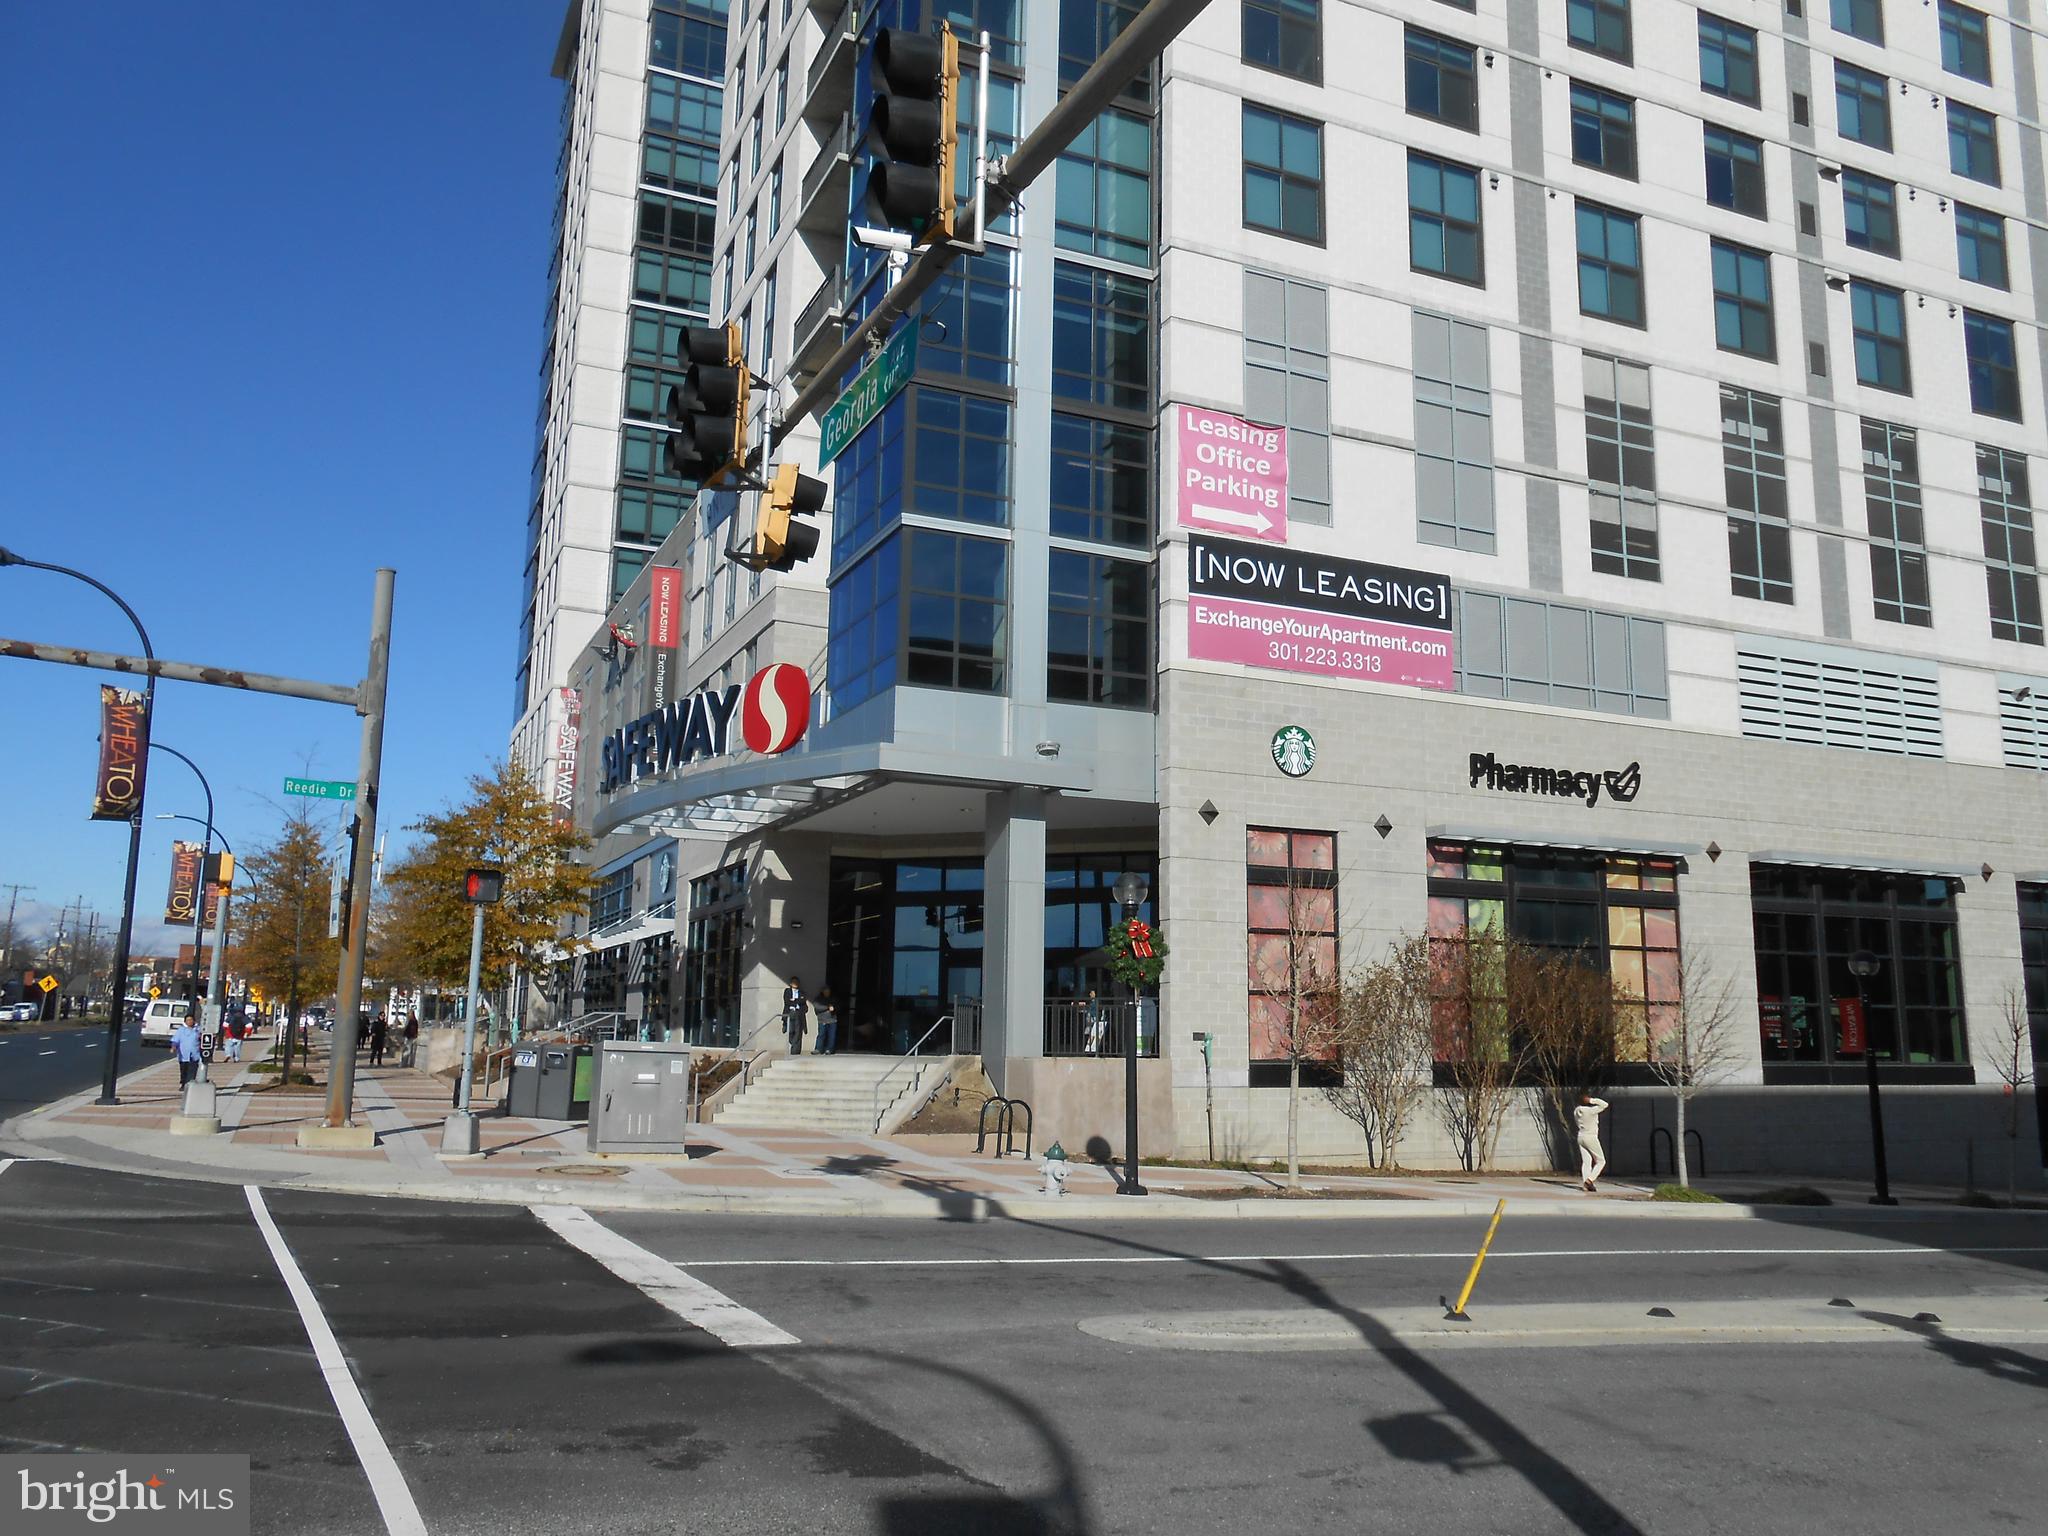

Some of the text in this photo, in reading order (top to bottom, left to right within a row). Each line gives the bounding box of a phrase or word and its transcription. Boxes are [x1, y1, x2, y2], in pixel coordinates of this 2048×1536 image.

[826, 378, 877, 450] Georgia
[1186, 412, 1279, 453] Leasing
[1196, 443, 1271, 476] Office
[1186, 468, 1279, 508] Parking
[659, 577, 670, 642] NOW LEASING
[1195, 606, 1447, 657] ExchangeYourApartment.com
[1268, 641, 1382, 673] 301.223.3313
[103, 706, 137, 816] WHEATON
[556, 723, 577, 810] SAFEWAY
[600, 683, 744, 794] SAFEWAY
[286, 780, 353, 798] Reedie Dr
[1469, 752, 1601, 808] Pharmacy
[171, 852, 195, 921] WHEATON
